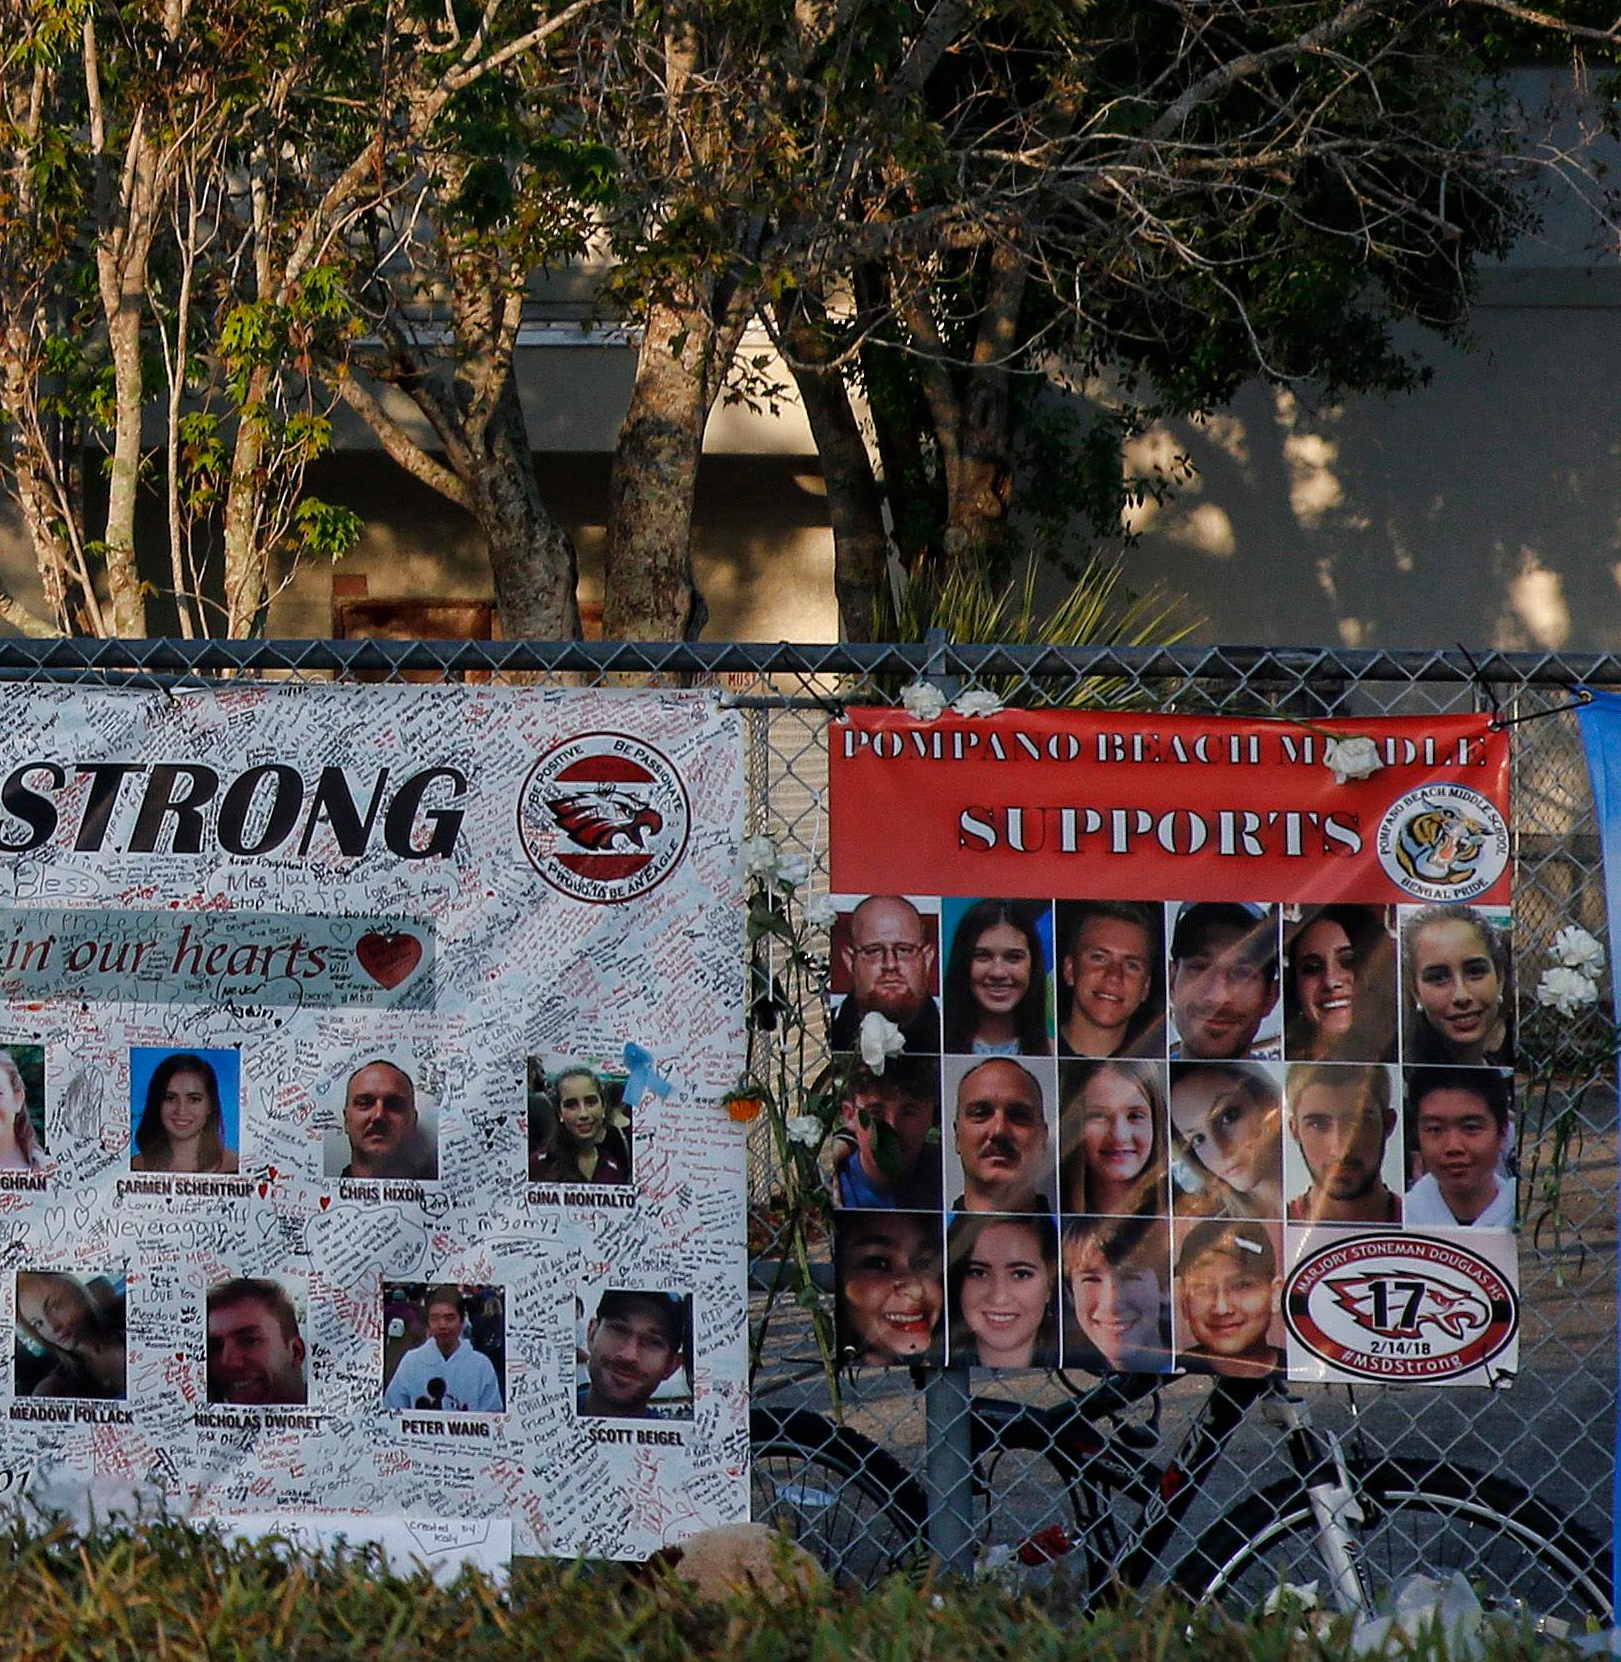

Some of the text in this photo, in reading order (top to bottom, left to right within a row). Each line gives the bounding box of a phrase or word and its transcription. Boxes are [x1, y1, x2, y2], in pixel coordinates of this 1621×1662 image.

[841, 728, 1081, 763] POMPANO
[1096, 732, 1261, 765] BEACH
[535, 744, 585, 785] POSITIVE
[613, 739, 685, 813] BE PASSIONATE
[959, 805, 1363, 858] SUPPORTS
[1380, 787, 1509, 857] POMPANO BEACH MIDDLE SCHOOL
[14, 858, 90, 899] Bless
[609, 886, 626, 899] BE
[644, 837, 679, 880] EAGLE
[1400, 877, 1490, 900] BENGAL PRIDE
[6, 924, 55, 971] in
[67, 938, 160, 974] our
[171, 923, 330, 979] hearts
[116, 1179, 255, 1197] CARMEN SCHENTRUP
[339, 1186, 425, 1202] CHRIS HIXON
[527, 1191, 636, 1207] GINA MONTALTO
[1297, 1242, 1506, 1302] MARJORY STONEMAN DOUGLAS HS
[142, 1289, 175, 1303] LOVE
[1368, 1280, 1427, 1330] 17
[1370, 1341, 1432, 1356] 2/14/18
[1341, 1349, 1463, 1374] #MSDStrong
[9, 1406, 134, 1424] MEADOW POLLACK
[193, 1412, 321, 1430] NICHOLAS DWORET
[401, 1420, 490, 1437] PETER WANG
[588, 1427, 684, 1446] SCOTT BEIGEL
